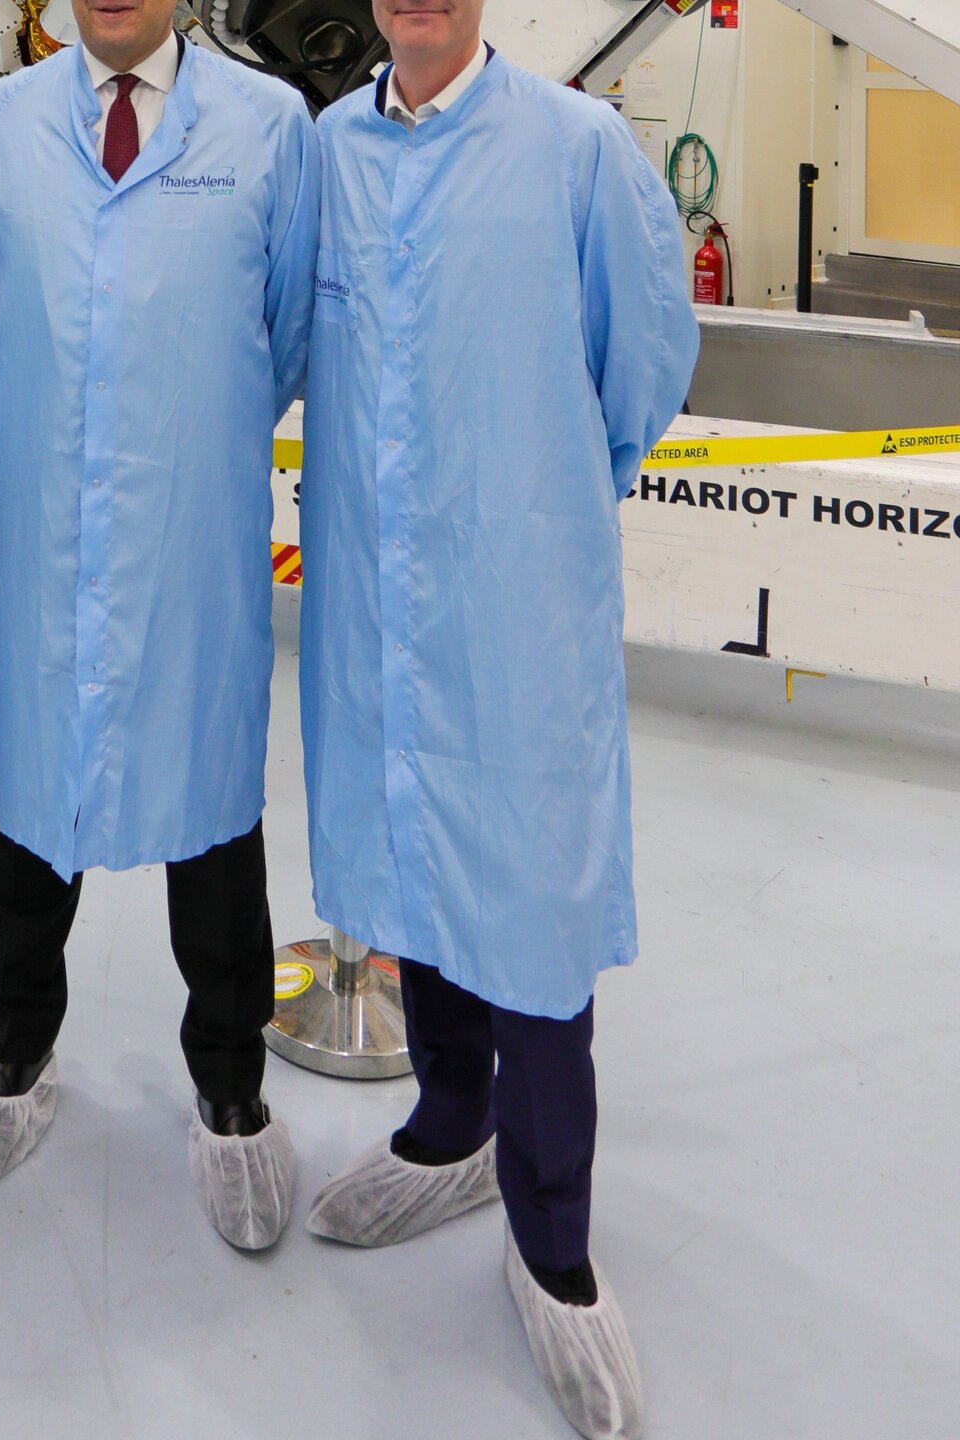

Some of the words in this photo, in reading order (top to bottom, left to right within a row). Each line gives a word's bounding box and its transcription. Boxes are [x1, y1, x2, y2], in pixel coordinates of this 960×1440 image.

[159, 175, 236, 188] ThalesAlenia
[207, 187, 234, 198] Space
[899, 436, 916, 448] ESD
[683, 447, 709, 459] AREA
[624, 474, 797, 518] HARIOT
[813, 495, 960, 540] HORIZ
